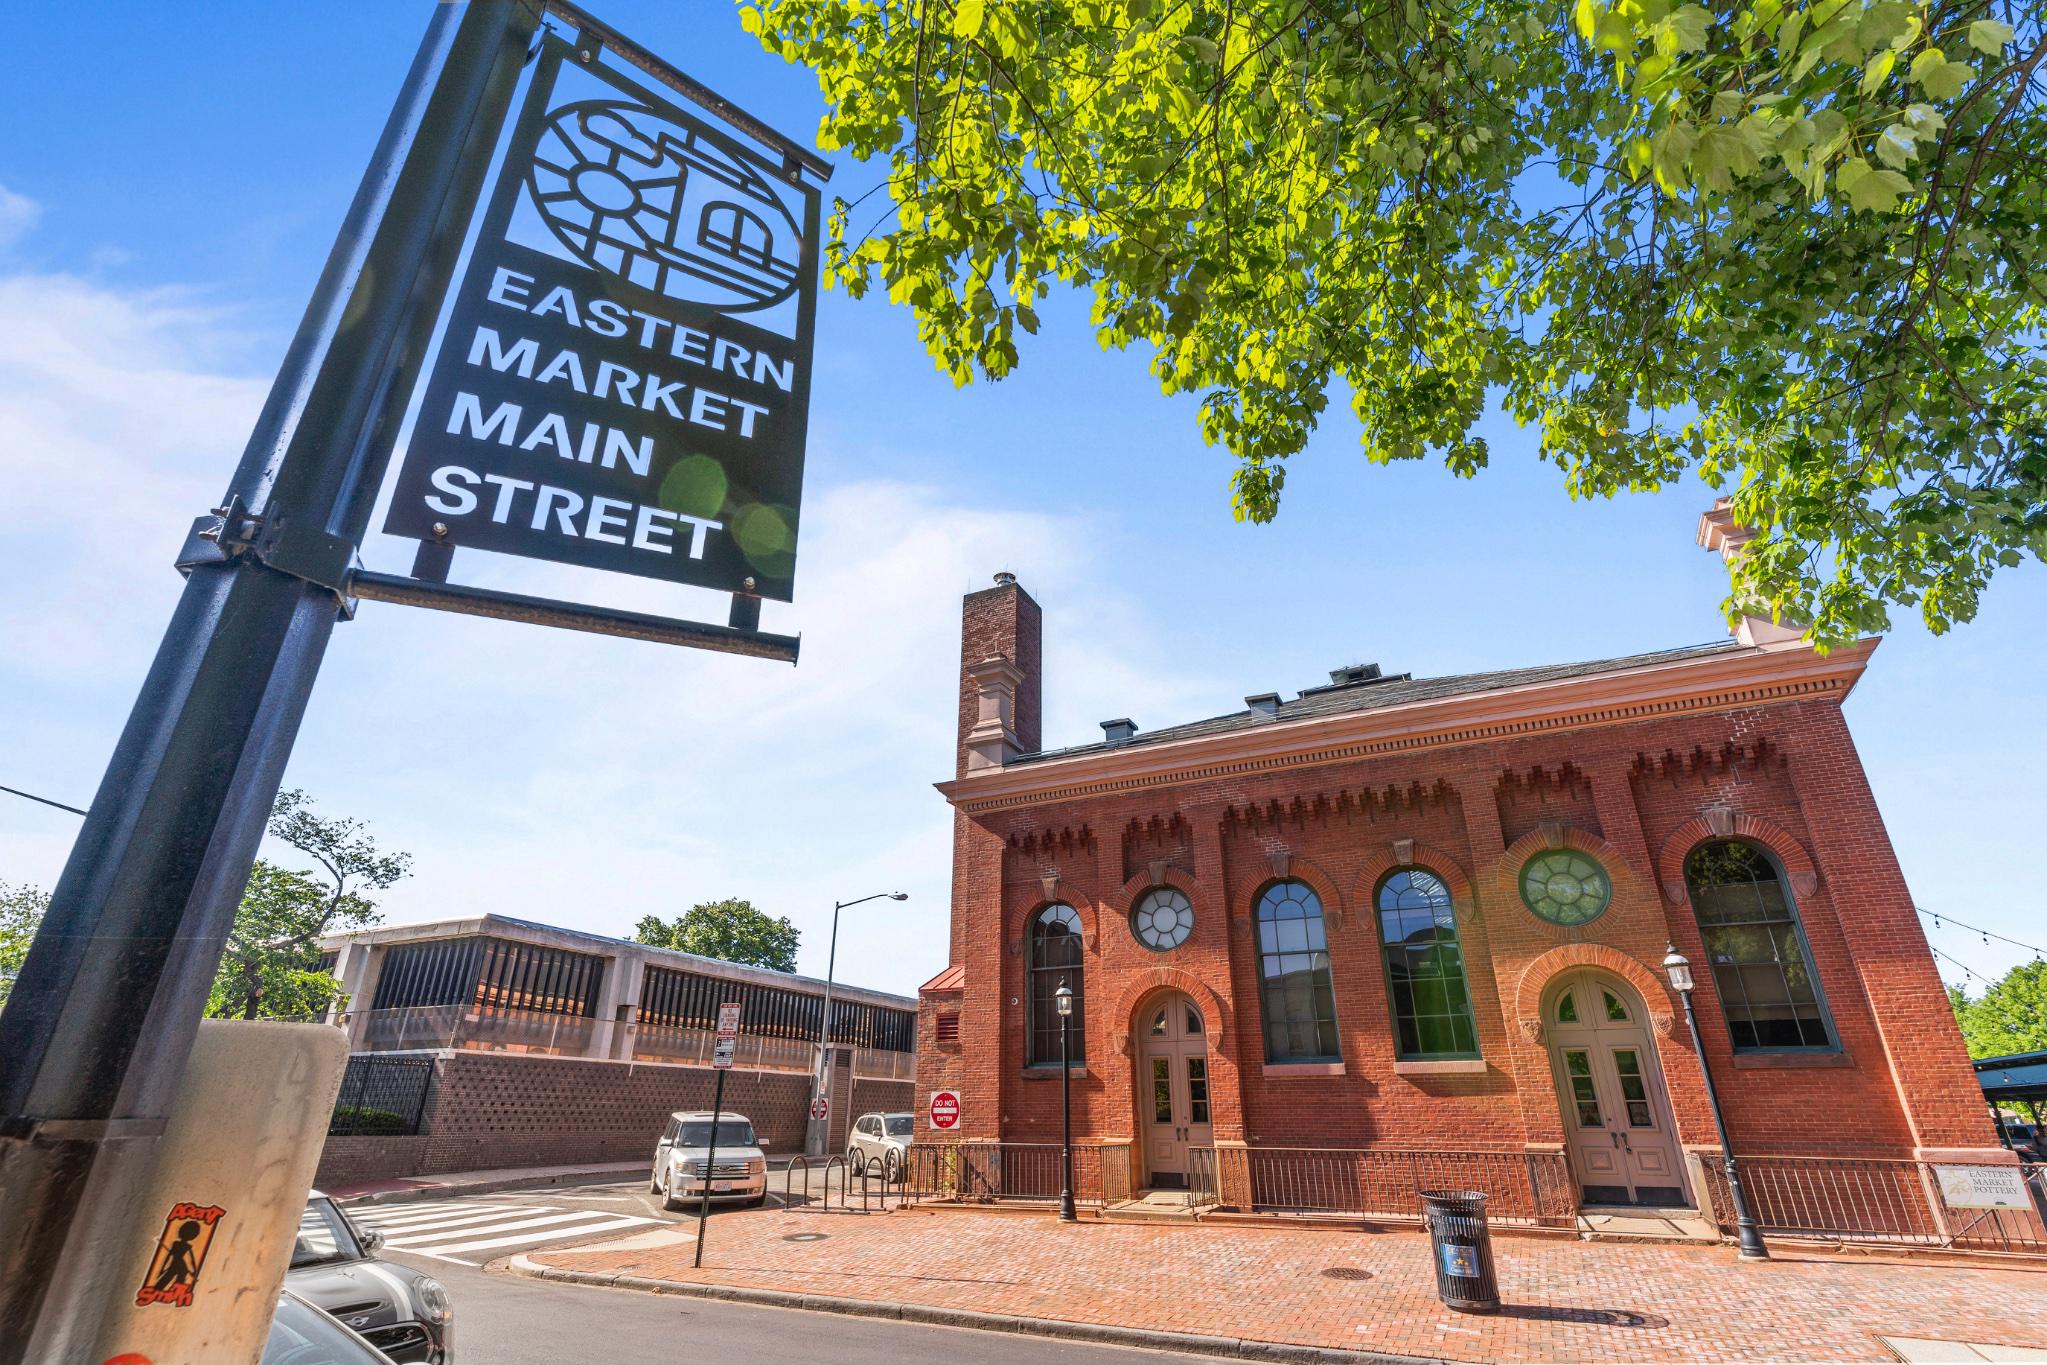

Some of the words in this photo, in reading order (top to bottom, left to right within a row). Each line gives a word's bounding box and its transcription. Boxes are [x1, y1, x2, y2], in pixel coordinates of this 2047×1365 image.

[486, 266, 794, 392] EASTERN
[467, 325, 769, 438] MARKET
[446, 391, 654, 477] MAIN
[425, 465, 723, 560] STREET
[1969, 1170, 2012, 1178] EASTERN
[1972, 1178, 2014, 1186] MARKET
[1973, 1186, 2017, 1194] POTTERY
